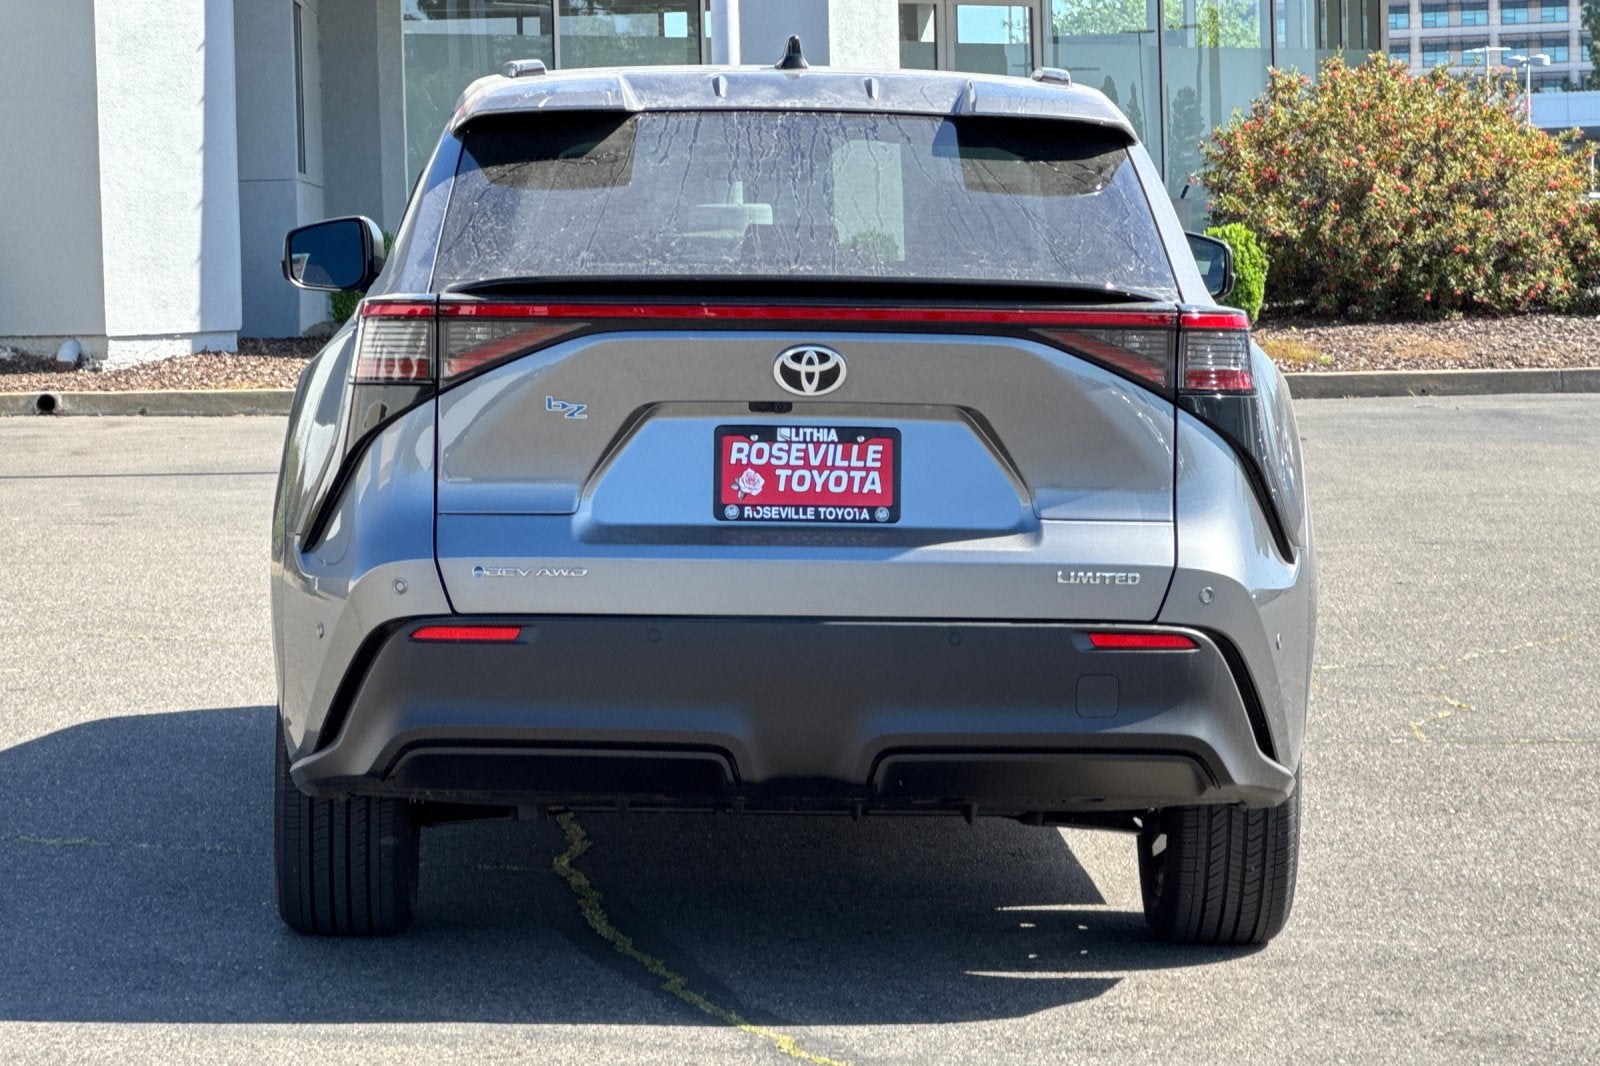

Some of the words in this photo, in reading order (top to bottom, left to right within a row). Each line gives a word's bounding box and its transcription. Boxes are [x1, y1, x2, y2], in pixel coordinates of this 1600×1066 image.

[792, 427, 838, 442] LITHIA
[730, 441, 883, 468] ROSEVILLE
[775, 468, 882, 494] TOYOTA
[744, 506, 815, 520] ROSEVILLE
[818, 507, 870, 521] TOYOTA
[535, 566, 588, 577] AWD
[1056, 570, 1141, 585] LIMITED
